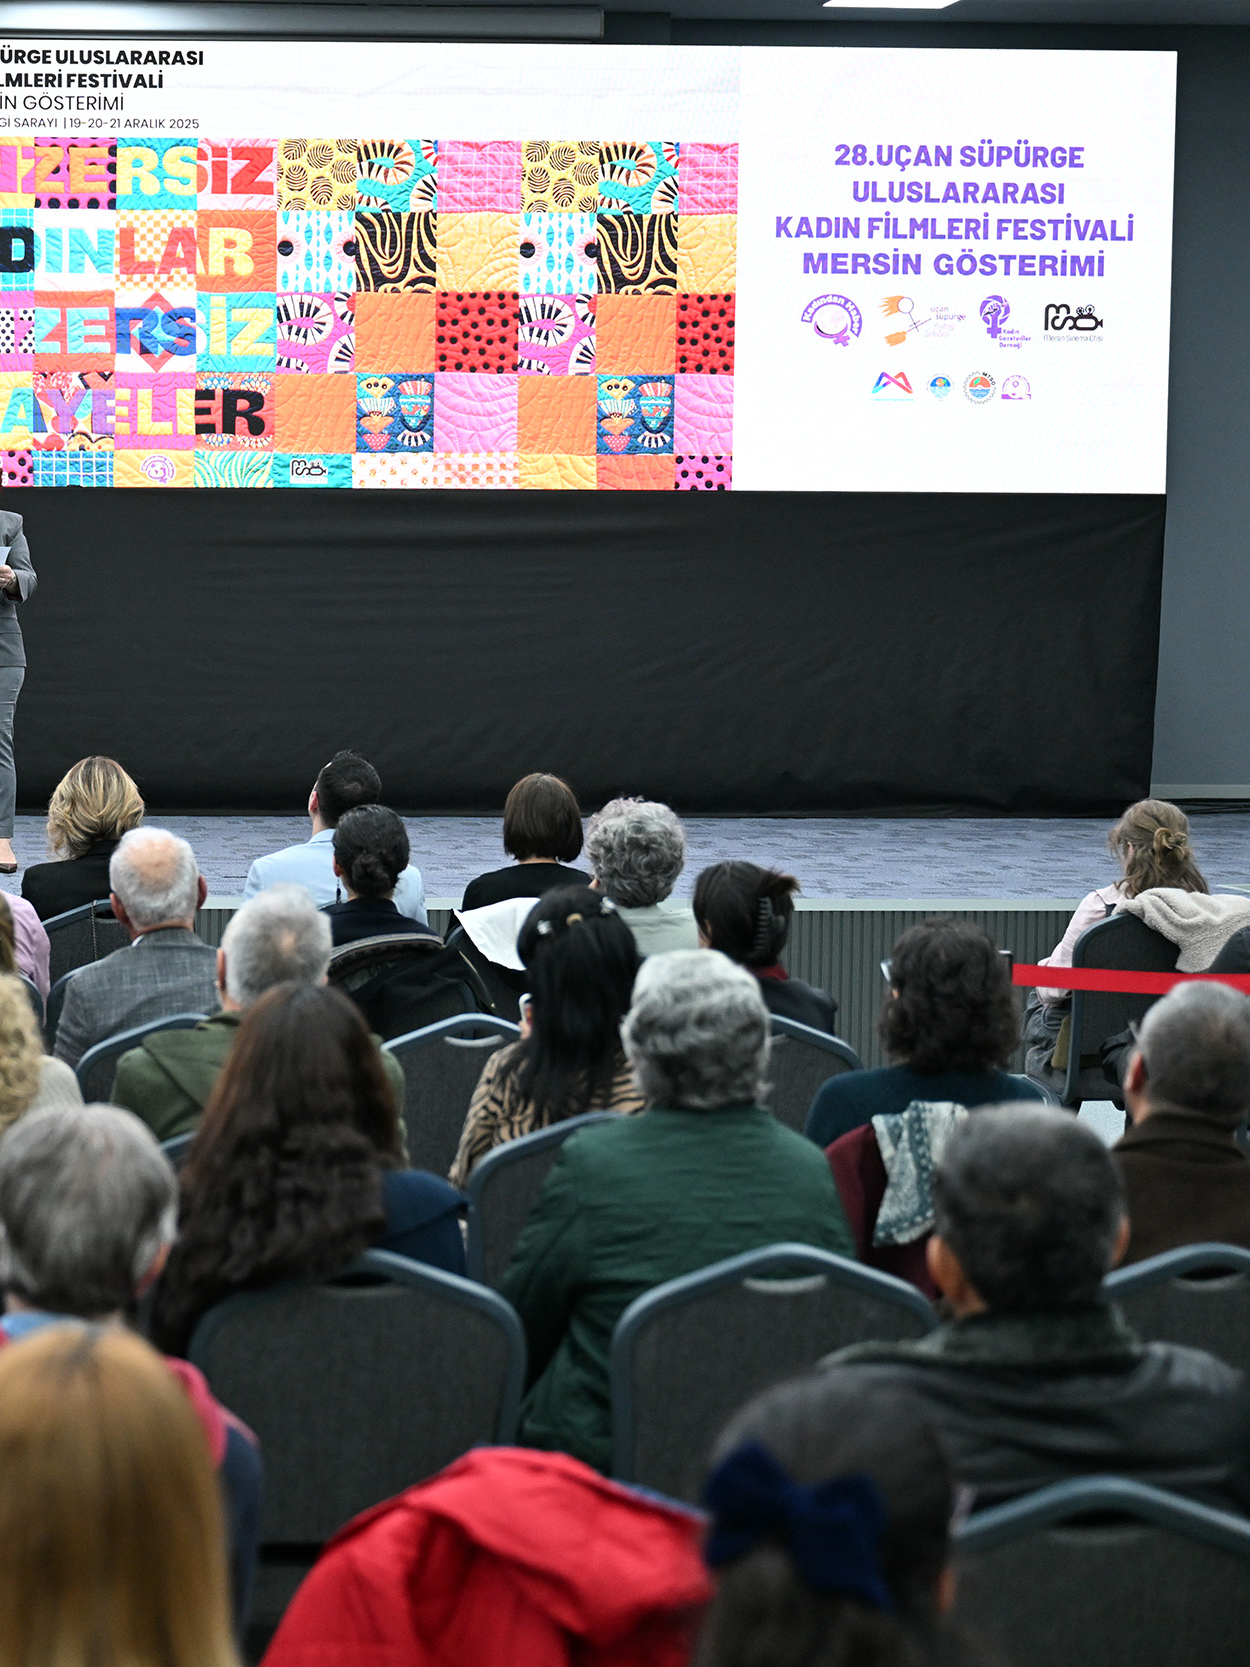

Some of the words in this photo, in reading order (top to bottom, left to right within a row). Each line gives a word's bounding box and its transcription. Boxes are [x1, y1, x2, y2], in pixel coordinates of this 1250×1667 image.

[56, 50, 204, 66] ULUSLARARASI
[67, 69, 164, 89] FESTİVALİ
[23, 91, 124, 111] GÖSTERİMİ
[14, 117, 58, 129] SARAYI
[124, 118, 166, 129] ARALIK
[170, 118, 200, 129] 2025
[834, 144, 953, 172] 28.UÇAN
[959, 138, 1085, 169] SÜPÜRGE
[852, 180, 1065, 205] ULUSLARARASI
[775, 216, 861, 239] KADIN
[867, 210, 990, 241] FİLMLERİ
[996, 212, 1134, 242] FESTİVALİ
[803, 247, 922, 276] MERSİN
[933, 248, 1105, 277] GÖSTERİMİ
